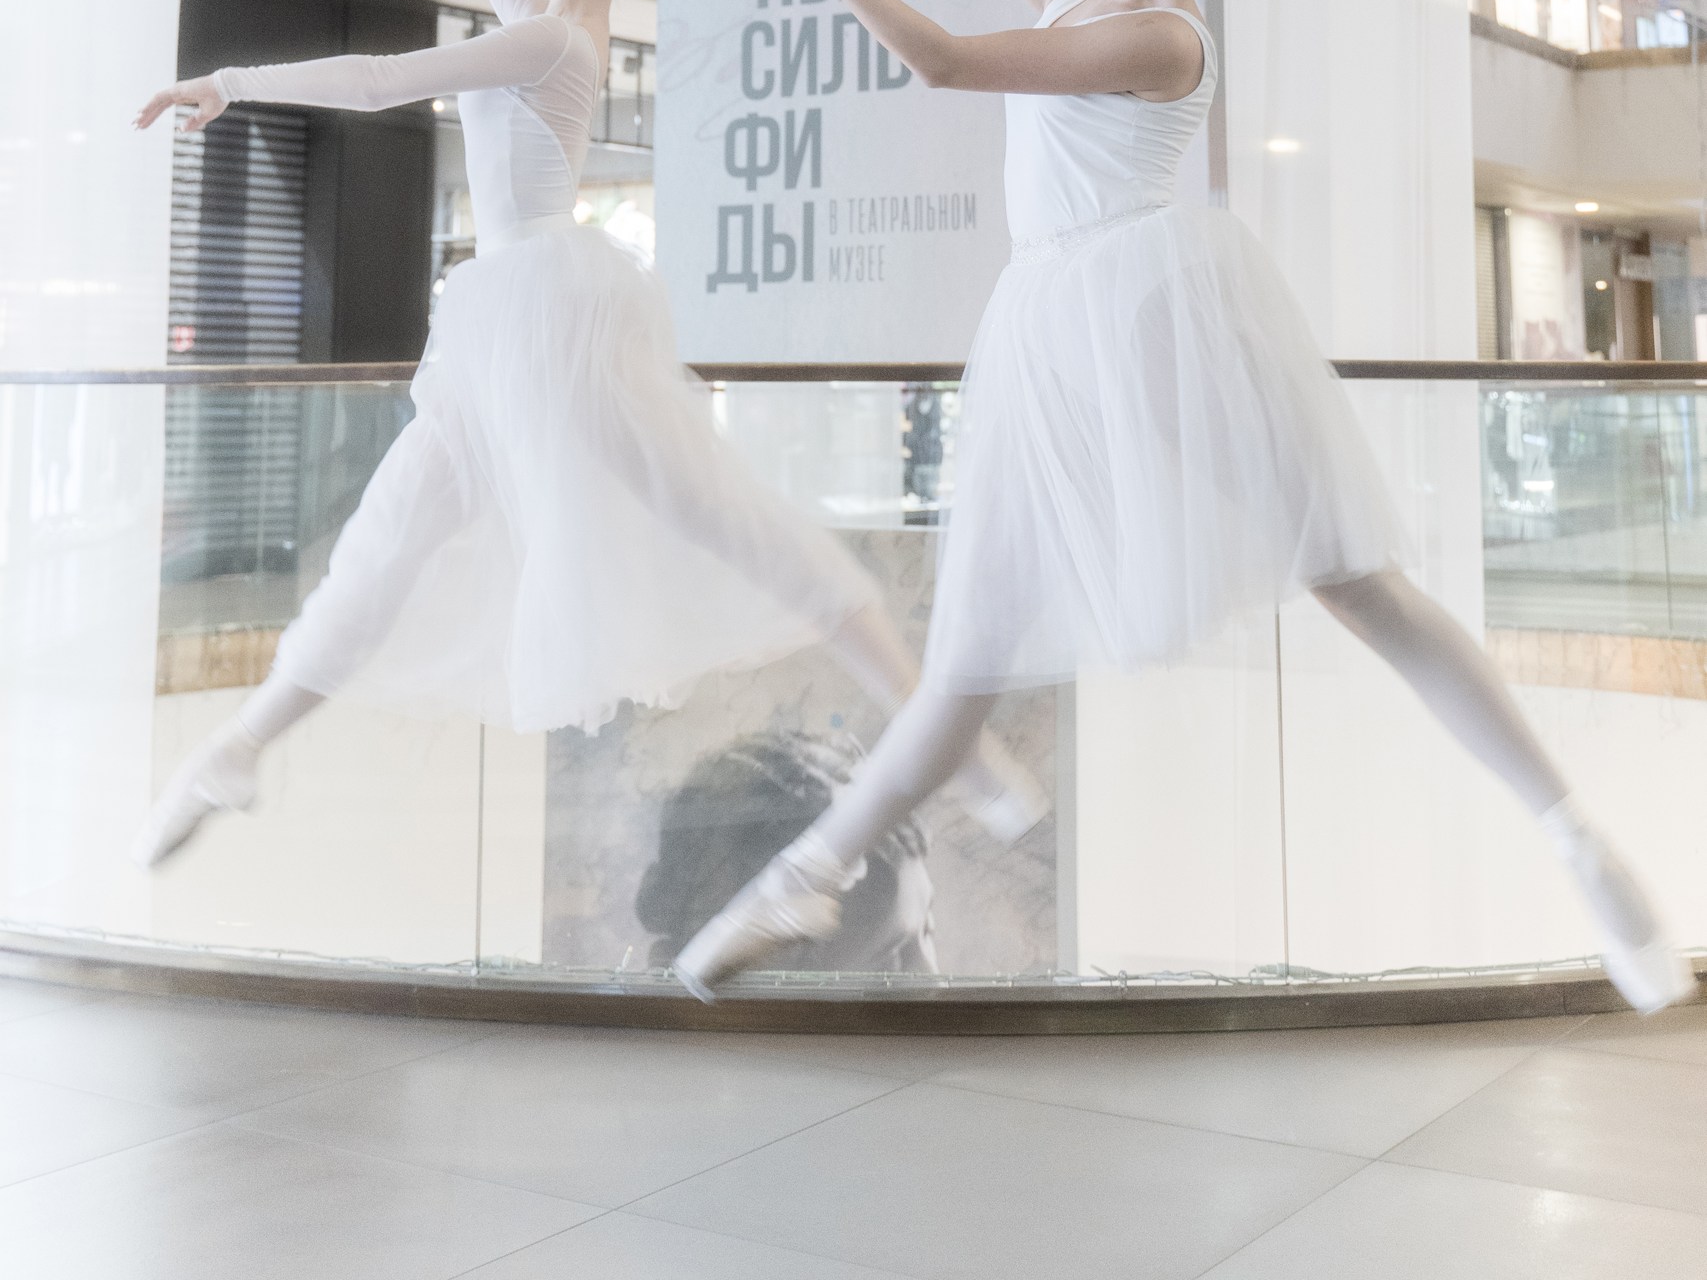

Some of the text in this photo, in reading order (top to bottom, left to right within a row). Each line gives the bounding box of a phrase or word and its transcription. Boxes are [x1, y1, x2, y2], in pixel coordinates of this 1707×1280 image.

[724, 107, 822, 192] ФИ
[829, 192, 977, 235] В ТЕАТРАЛЬНОМ
[706, 201, 815, 293] ДЫ
[828, 244, 885, 282] МУЗЕЕ
